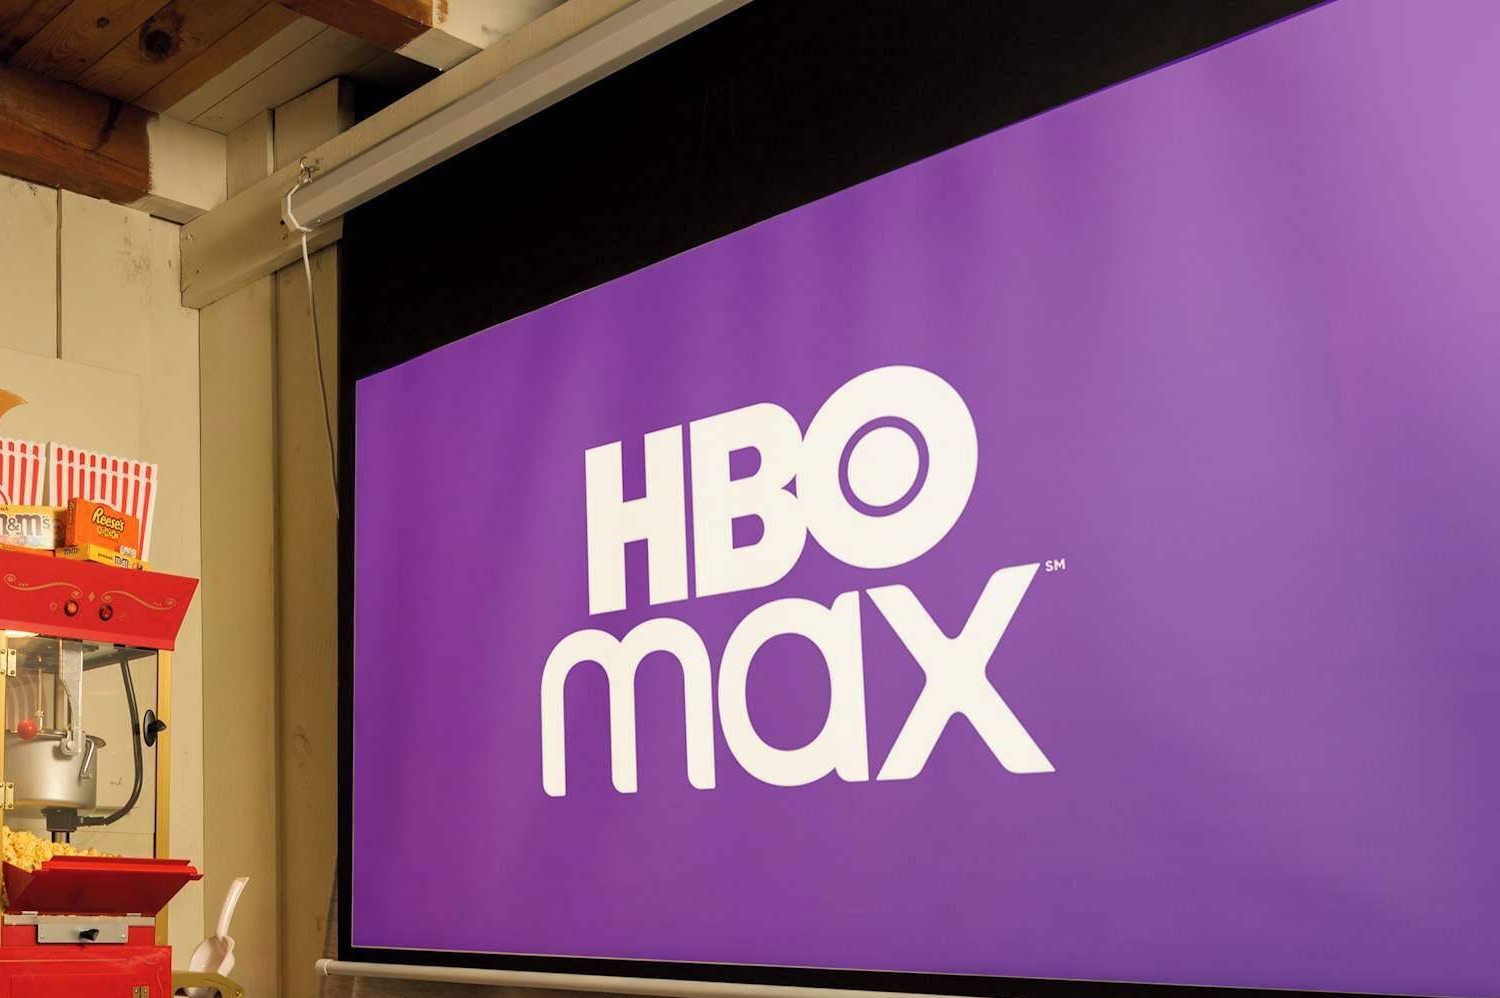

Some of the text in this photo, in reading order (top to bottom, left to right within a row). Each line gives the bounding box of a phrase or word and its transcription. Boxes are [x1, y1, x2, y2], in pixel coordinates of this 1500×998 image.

[585, 365, 979, 616] HBO
[541, 558, 1066, 798] max SM
